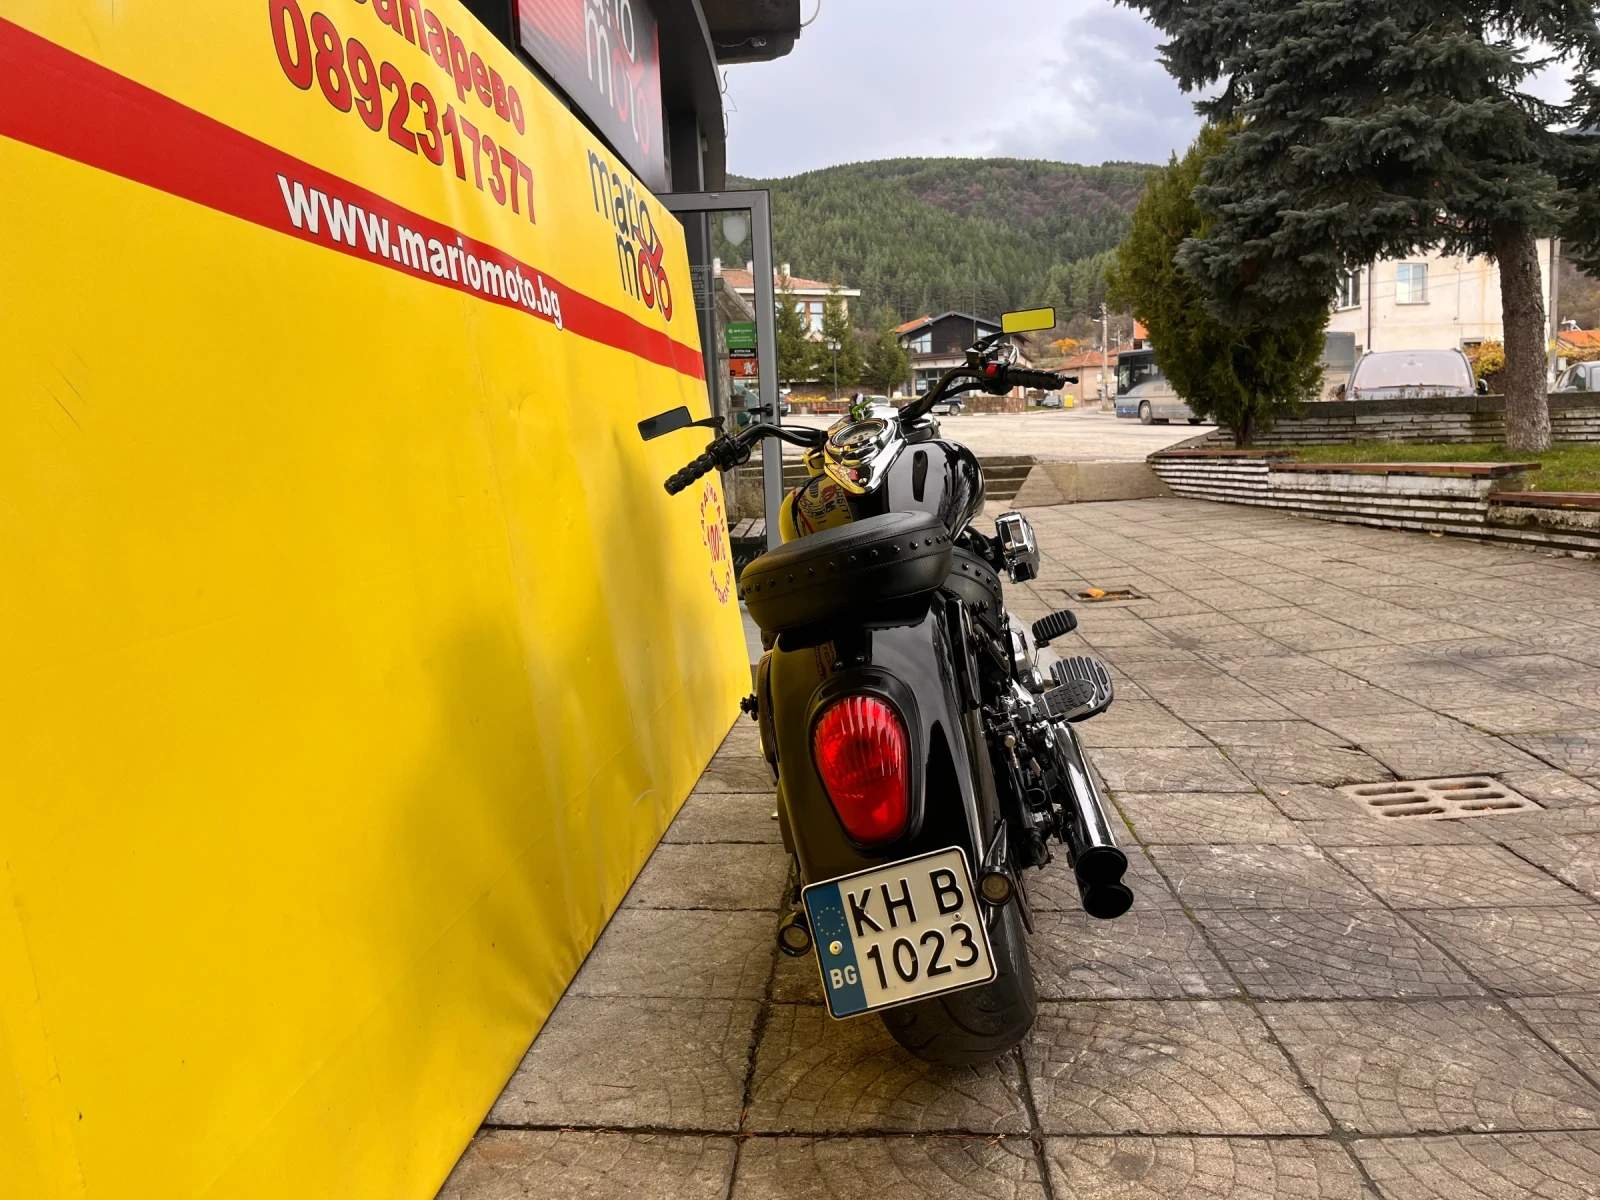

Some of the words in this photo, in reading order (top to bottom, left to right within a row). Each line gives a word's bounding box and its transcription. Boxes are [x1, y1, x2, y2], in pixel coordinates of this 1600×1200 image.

[269, 0, 536, 225] 0892317377
[587, 149, 653, 250] mario
[276, 172, 563, 331] www.mariomoto.bg
[616, 233, 672, 322] moto
[706, 523, 726, 563] 100%
[847, 877, 918, 937] KH
[929, 868, 964, 915] B
[829, 965, 857, 989] BG
[866, 922, 979, 990] 1023
